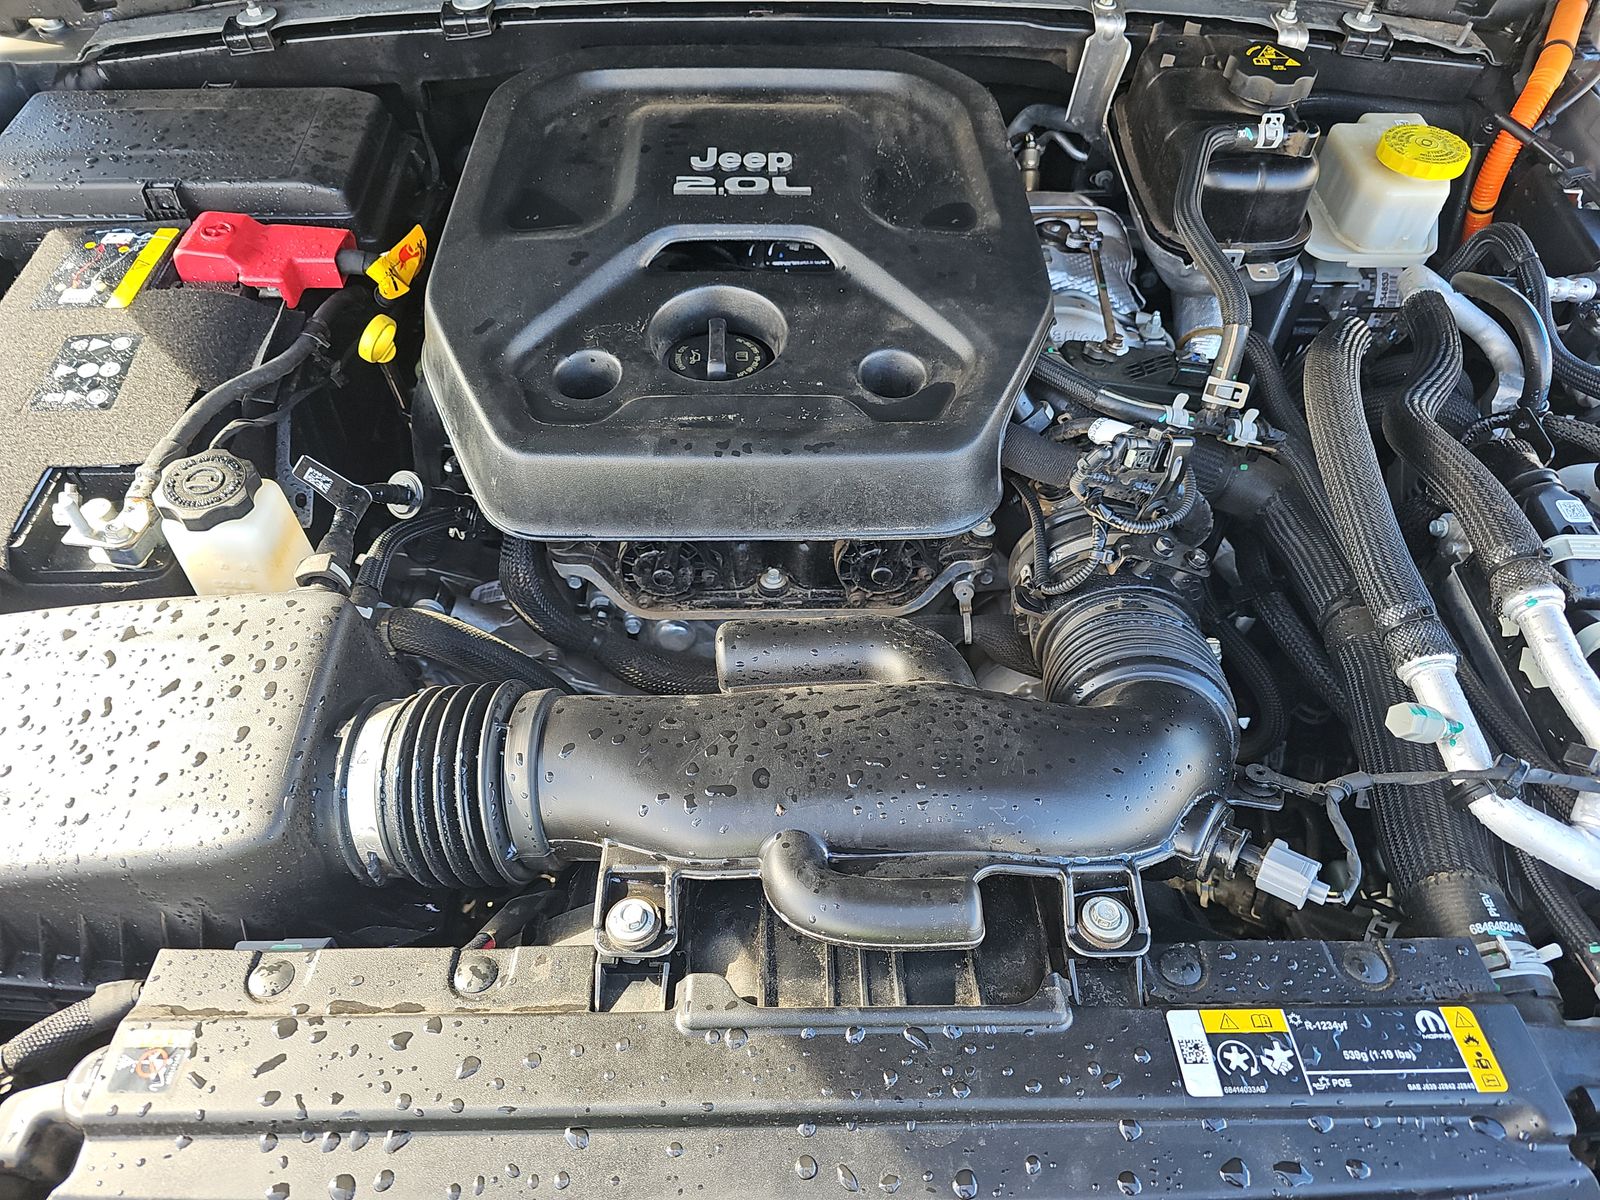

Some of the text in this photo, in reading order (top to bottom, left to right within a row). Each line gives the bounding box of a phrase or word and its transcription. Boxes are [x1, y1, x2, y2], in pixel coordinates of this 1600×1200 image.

[690, 147, 793, 175] Jeep
[673, 176, 812, 196] 2.0L
[1479, 892, 1500, 917] PHEV
[1304, 1020, 1349, 1032] R-1234yf
[1343, 1050, 1369, 1062] 539g
[1331, 1078, 1352, 1088] POE
